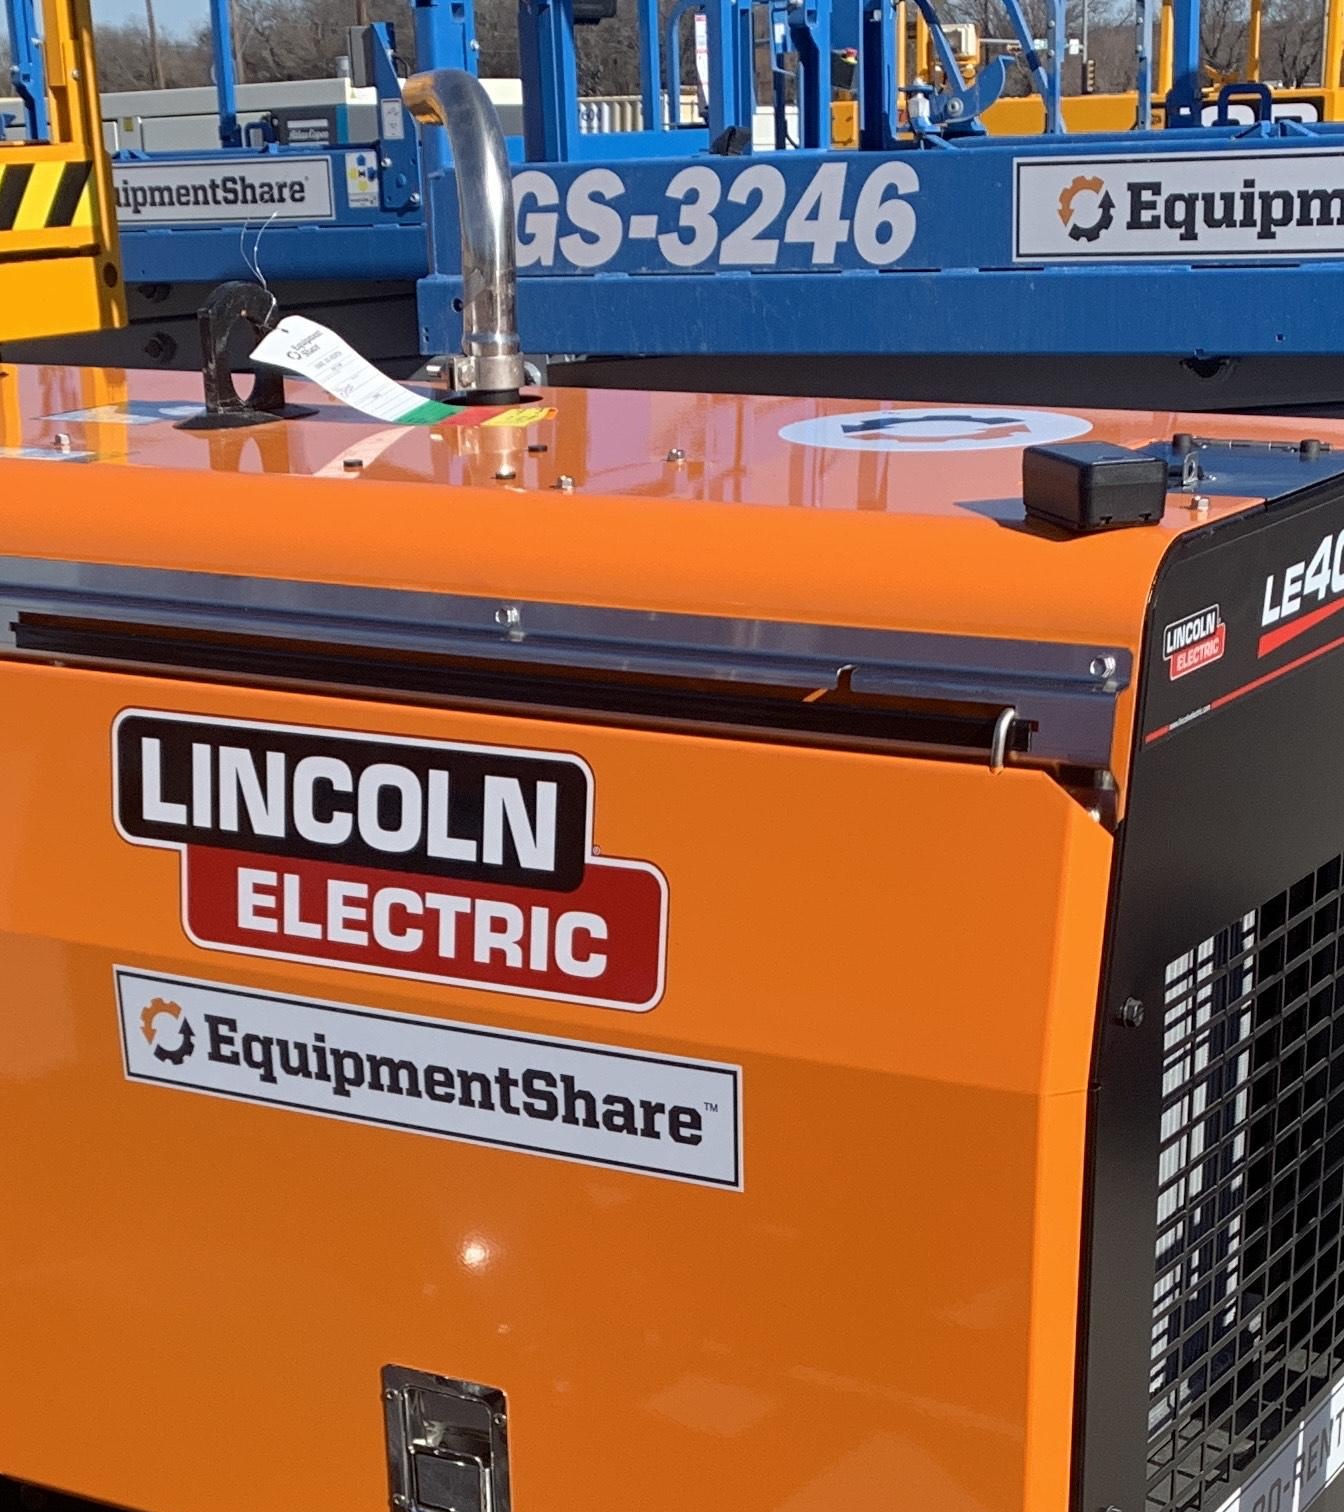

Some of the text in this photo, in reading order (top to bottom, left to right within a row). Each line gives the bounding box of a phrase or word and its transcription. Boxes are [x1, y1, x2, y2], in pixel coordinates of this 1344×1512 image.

[513, 160, 920, 268] GS-3246
[1166, 611, 1216, 653] LINCOLN
[1176, 636, 1221, 670] ELECTRIC
[141, 737, 558, 872] LINCOLN
[236, 866, 609, 979] ELECTRIC
[203, 1013, 704, 1147] EquipmentShare
